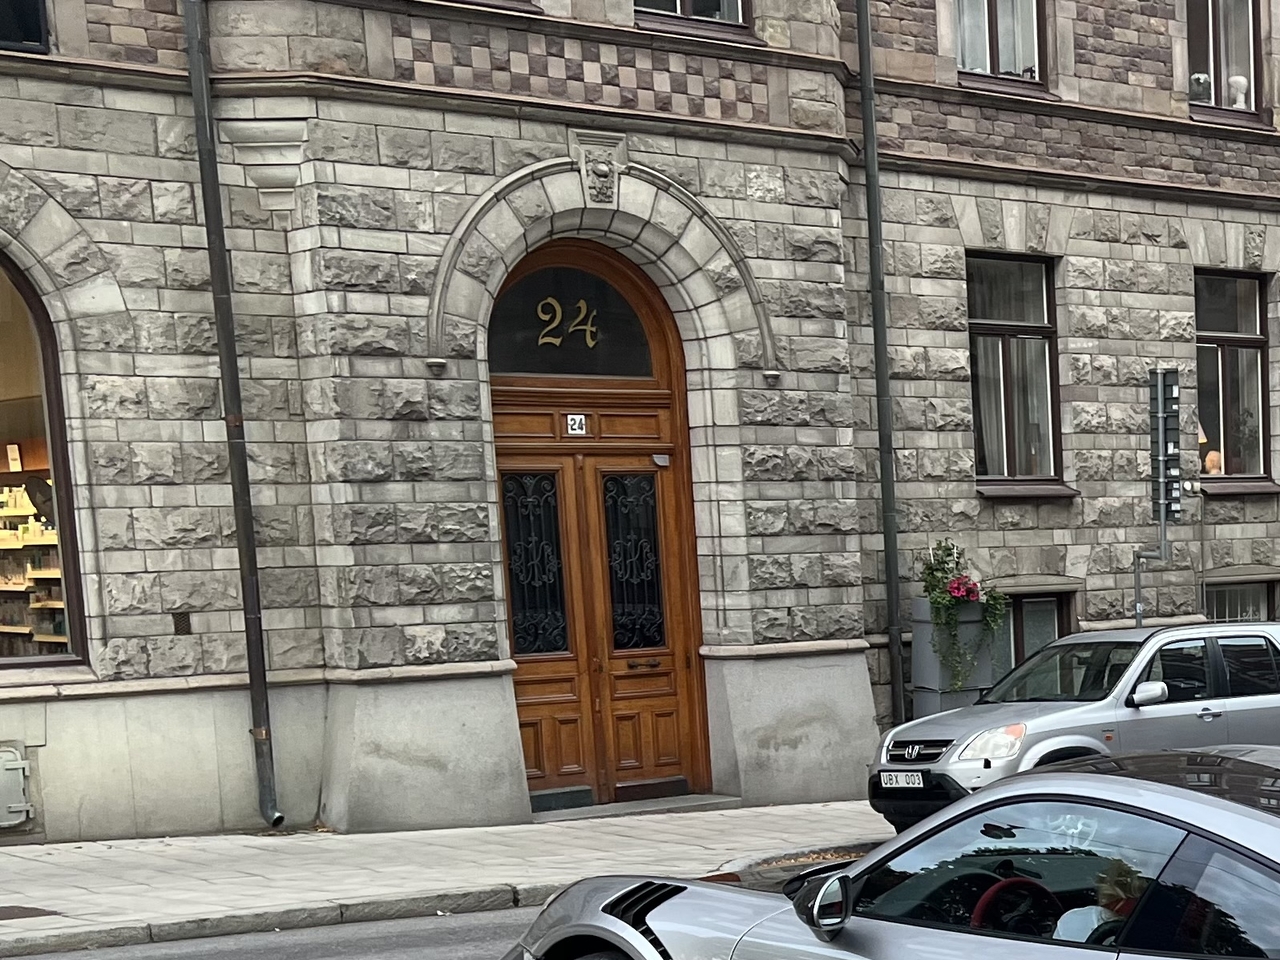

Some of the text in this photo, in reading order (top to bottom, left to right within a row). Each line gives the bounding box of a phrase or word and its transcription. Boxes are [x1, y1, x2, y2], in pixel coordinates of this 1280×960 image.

[536, 296, 599, 349] 24
[570, 418, 585, 431] 24
[882, 773, 922, 786] UBX 003
